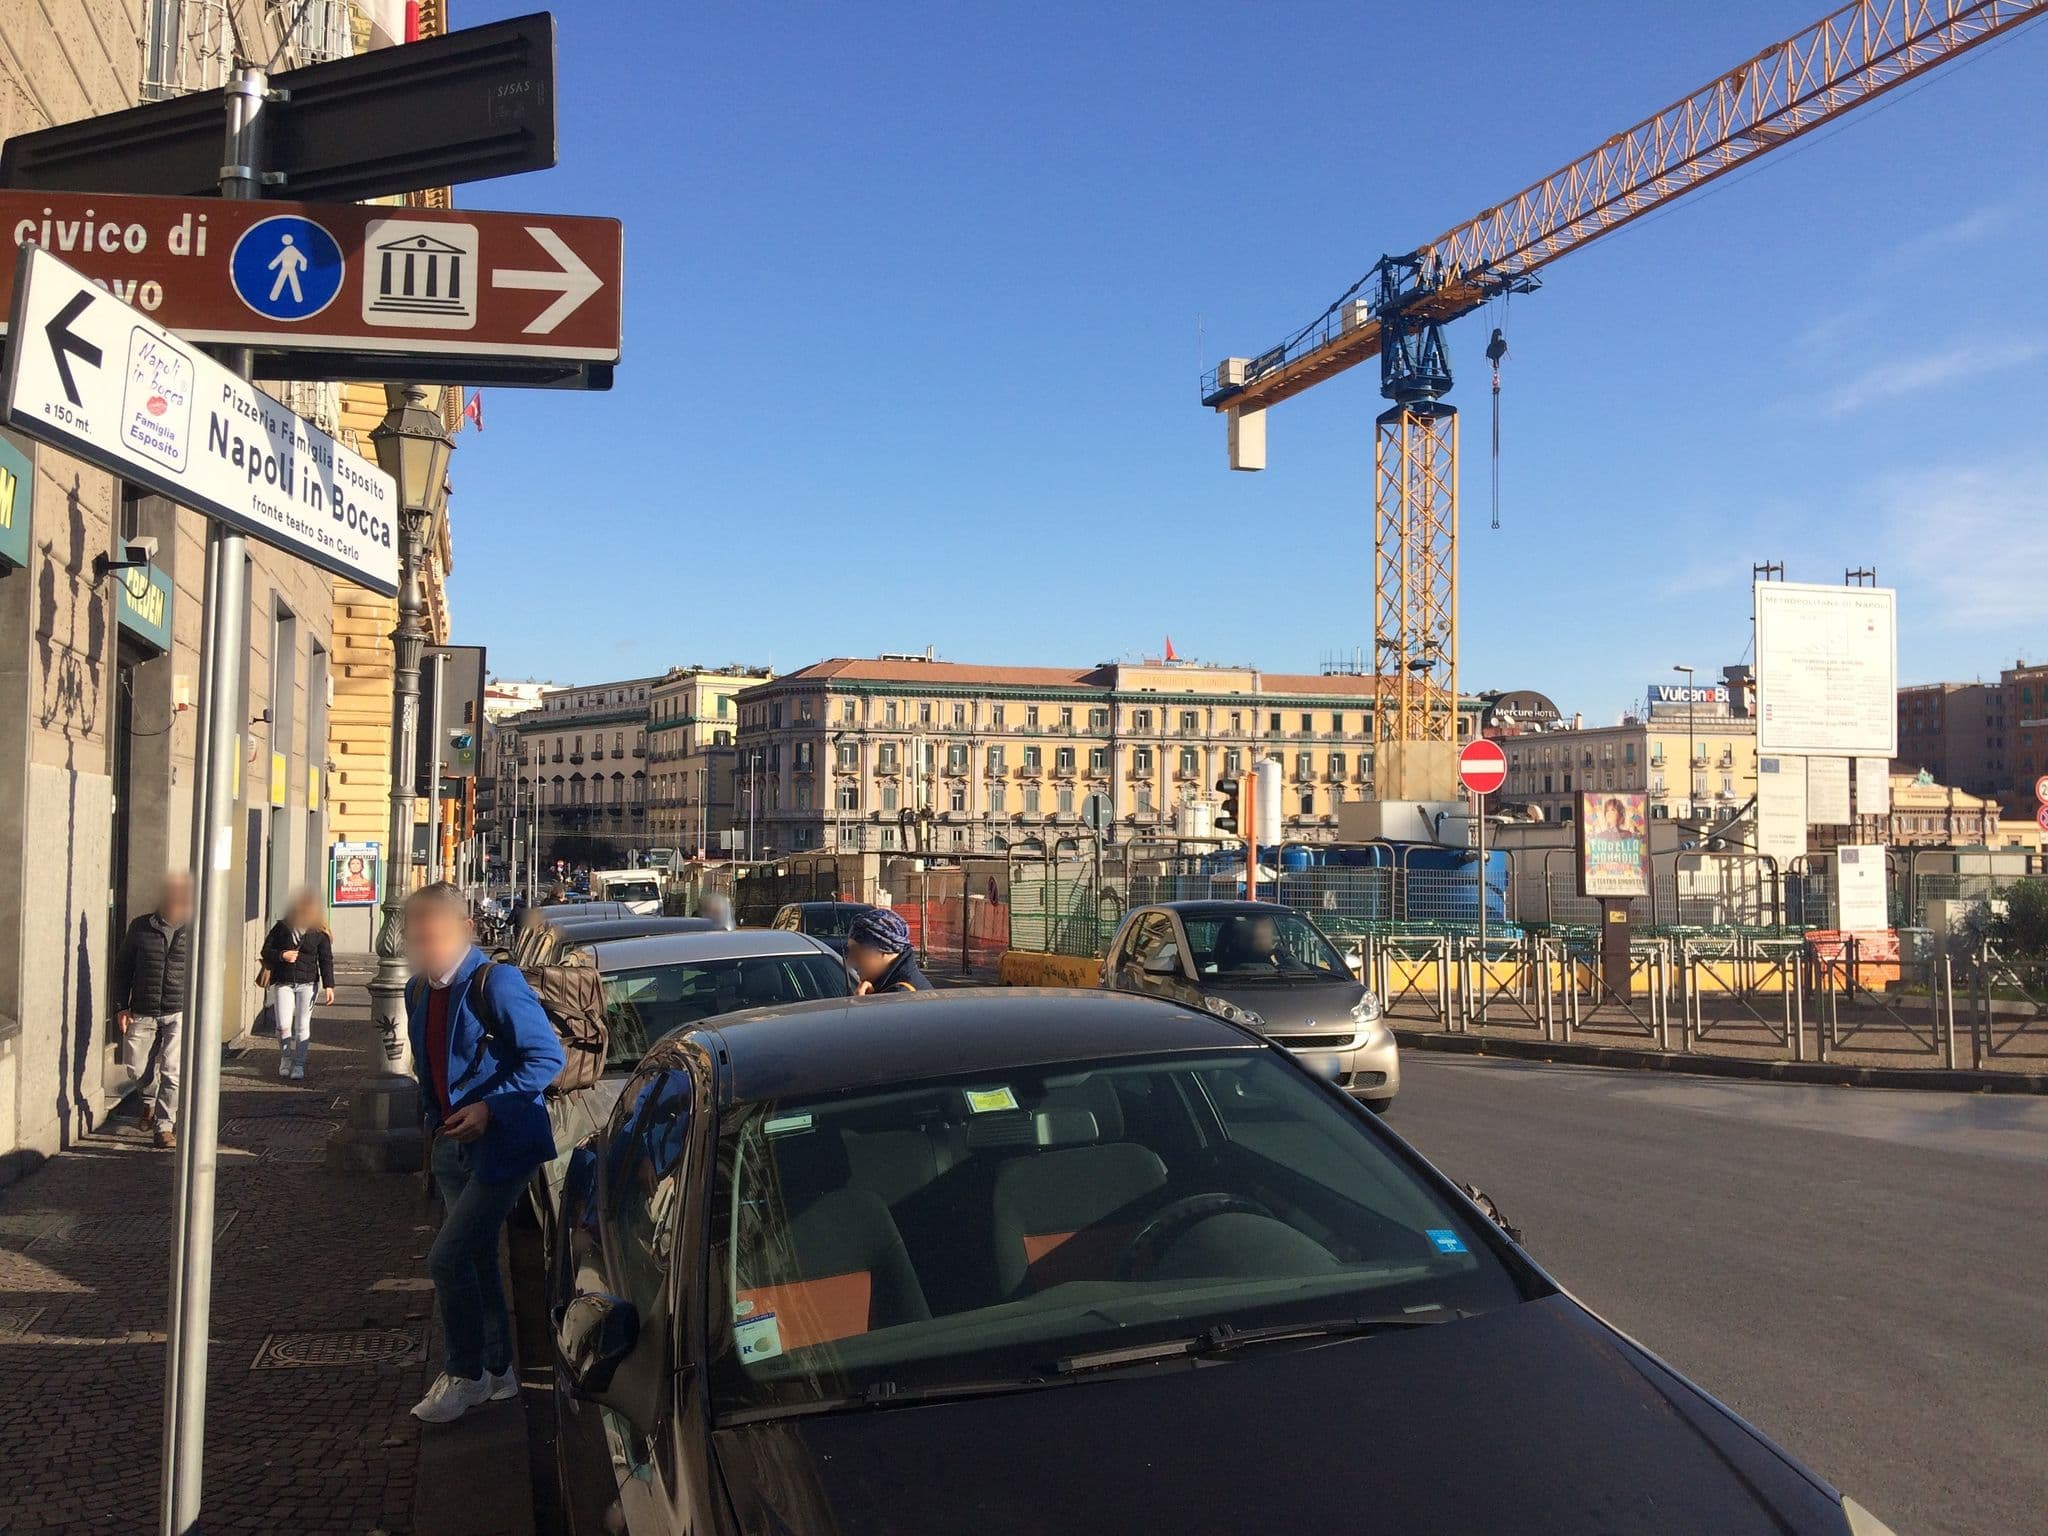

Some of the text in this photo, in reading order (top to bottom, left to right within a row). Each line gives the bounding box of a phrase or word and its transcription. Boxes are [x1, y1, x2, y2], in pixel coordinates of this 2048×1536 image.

[13, 207, 207, 257] civico di
[44, 402, 92, 435] a 150 mt.
[135, 412, 176, 440] Famiglia
[130, 424, 179, 458] Esposito
[223, 383, 385, 502] Pizzeria Famiglia Esposito
[208, 410, 391, 550] Napoli in Bocca
[252, 494, 360, 561] fronte teatro San Carlo
[126, 566, 165, 630] CREDEM
[1495, 708, 1557, 718] Mercure HOTEL
[1591, 838, 1640, 852] FIORELLA
[743, 1345, 754, 1355] R
